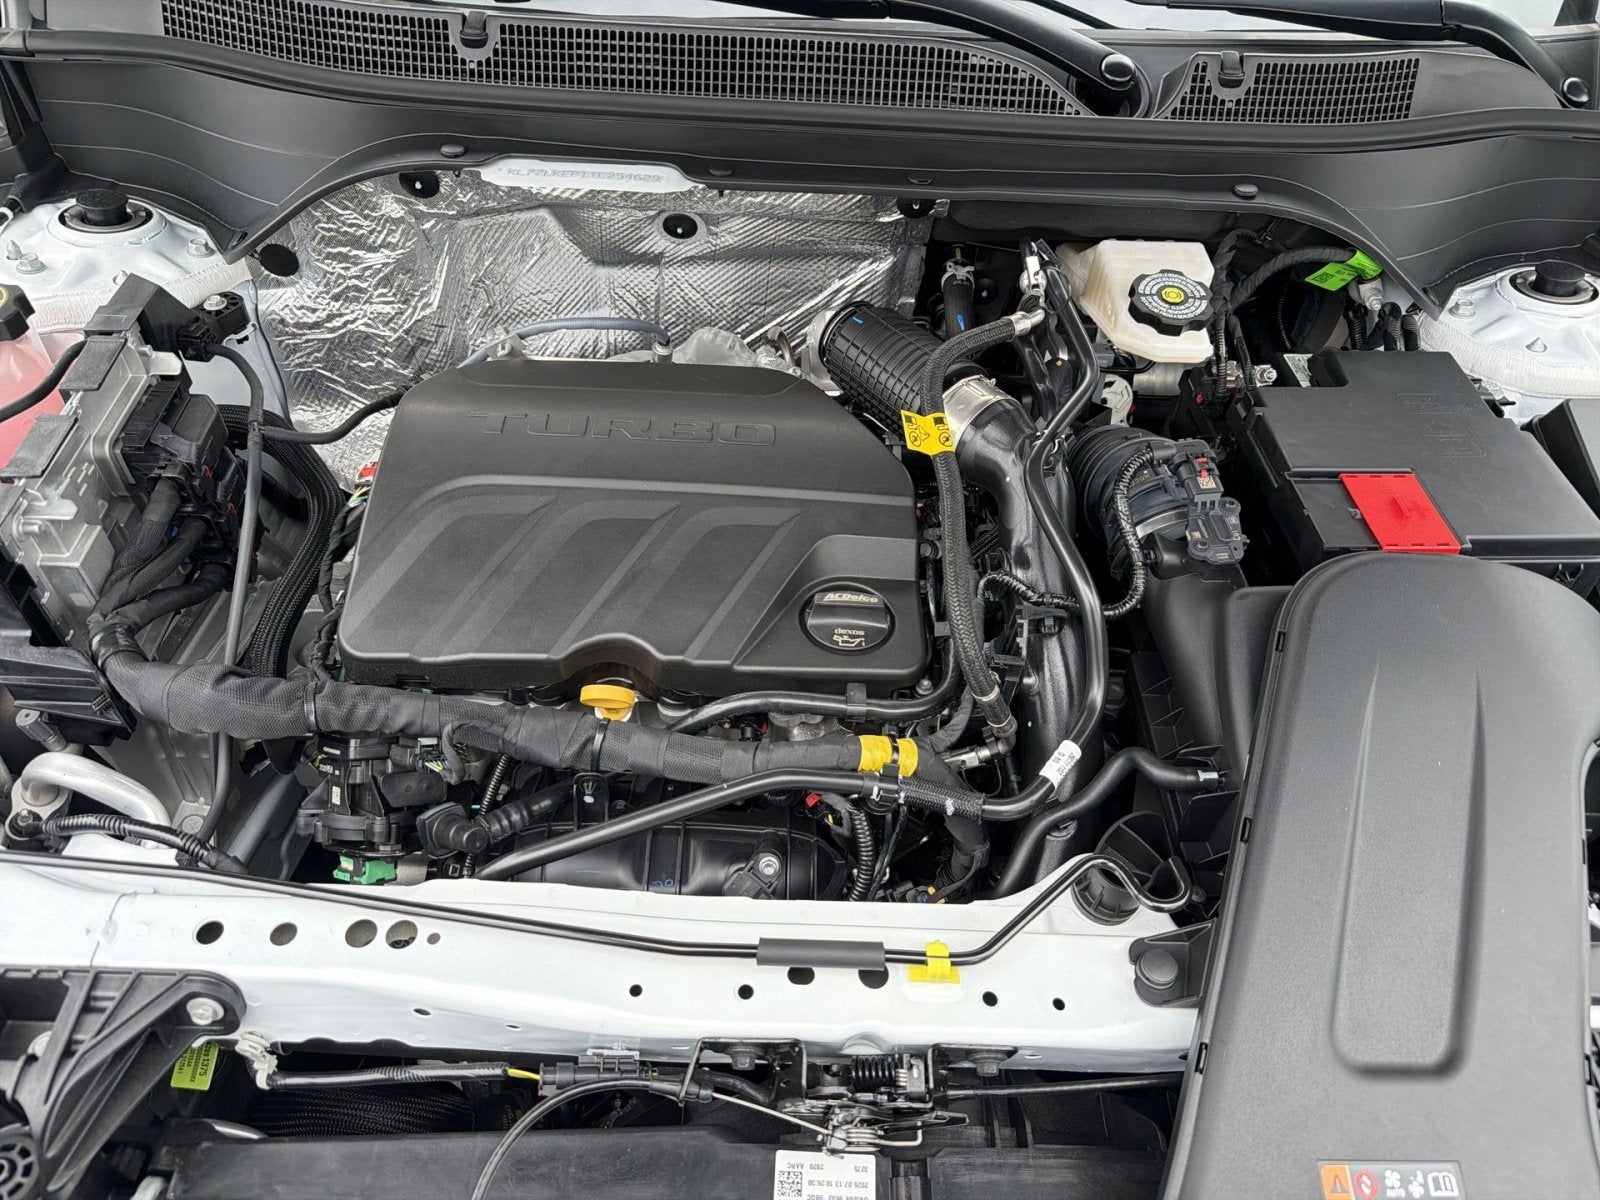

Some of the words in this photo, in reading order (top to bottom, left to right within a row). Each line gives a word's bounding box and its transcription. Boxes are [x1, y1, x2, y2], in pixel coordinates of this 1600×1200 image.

[468, 411, 776, 446] TURBO
[822, 592, 879, 603] ACDelco
[834, 627, 865, 636] dexos
